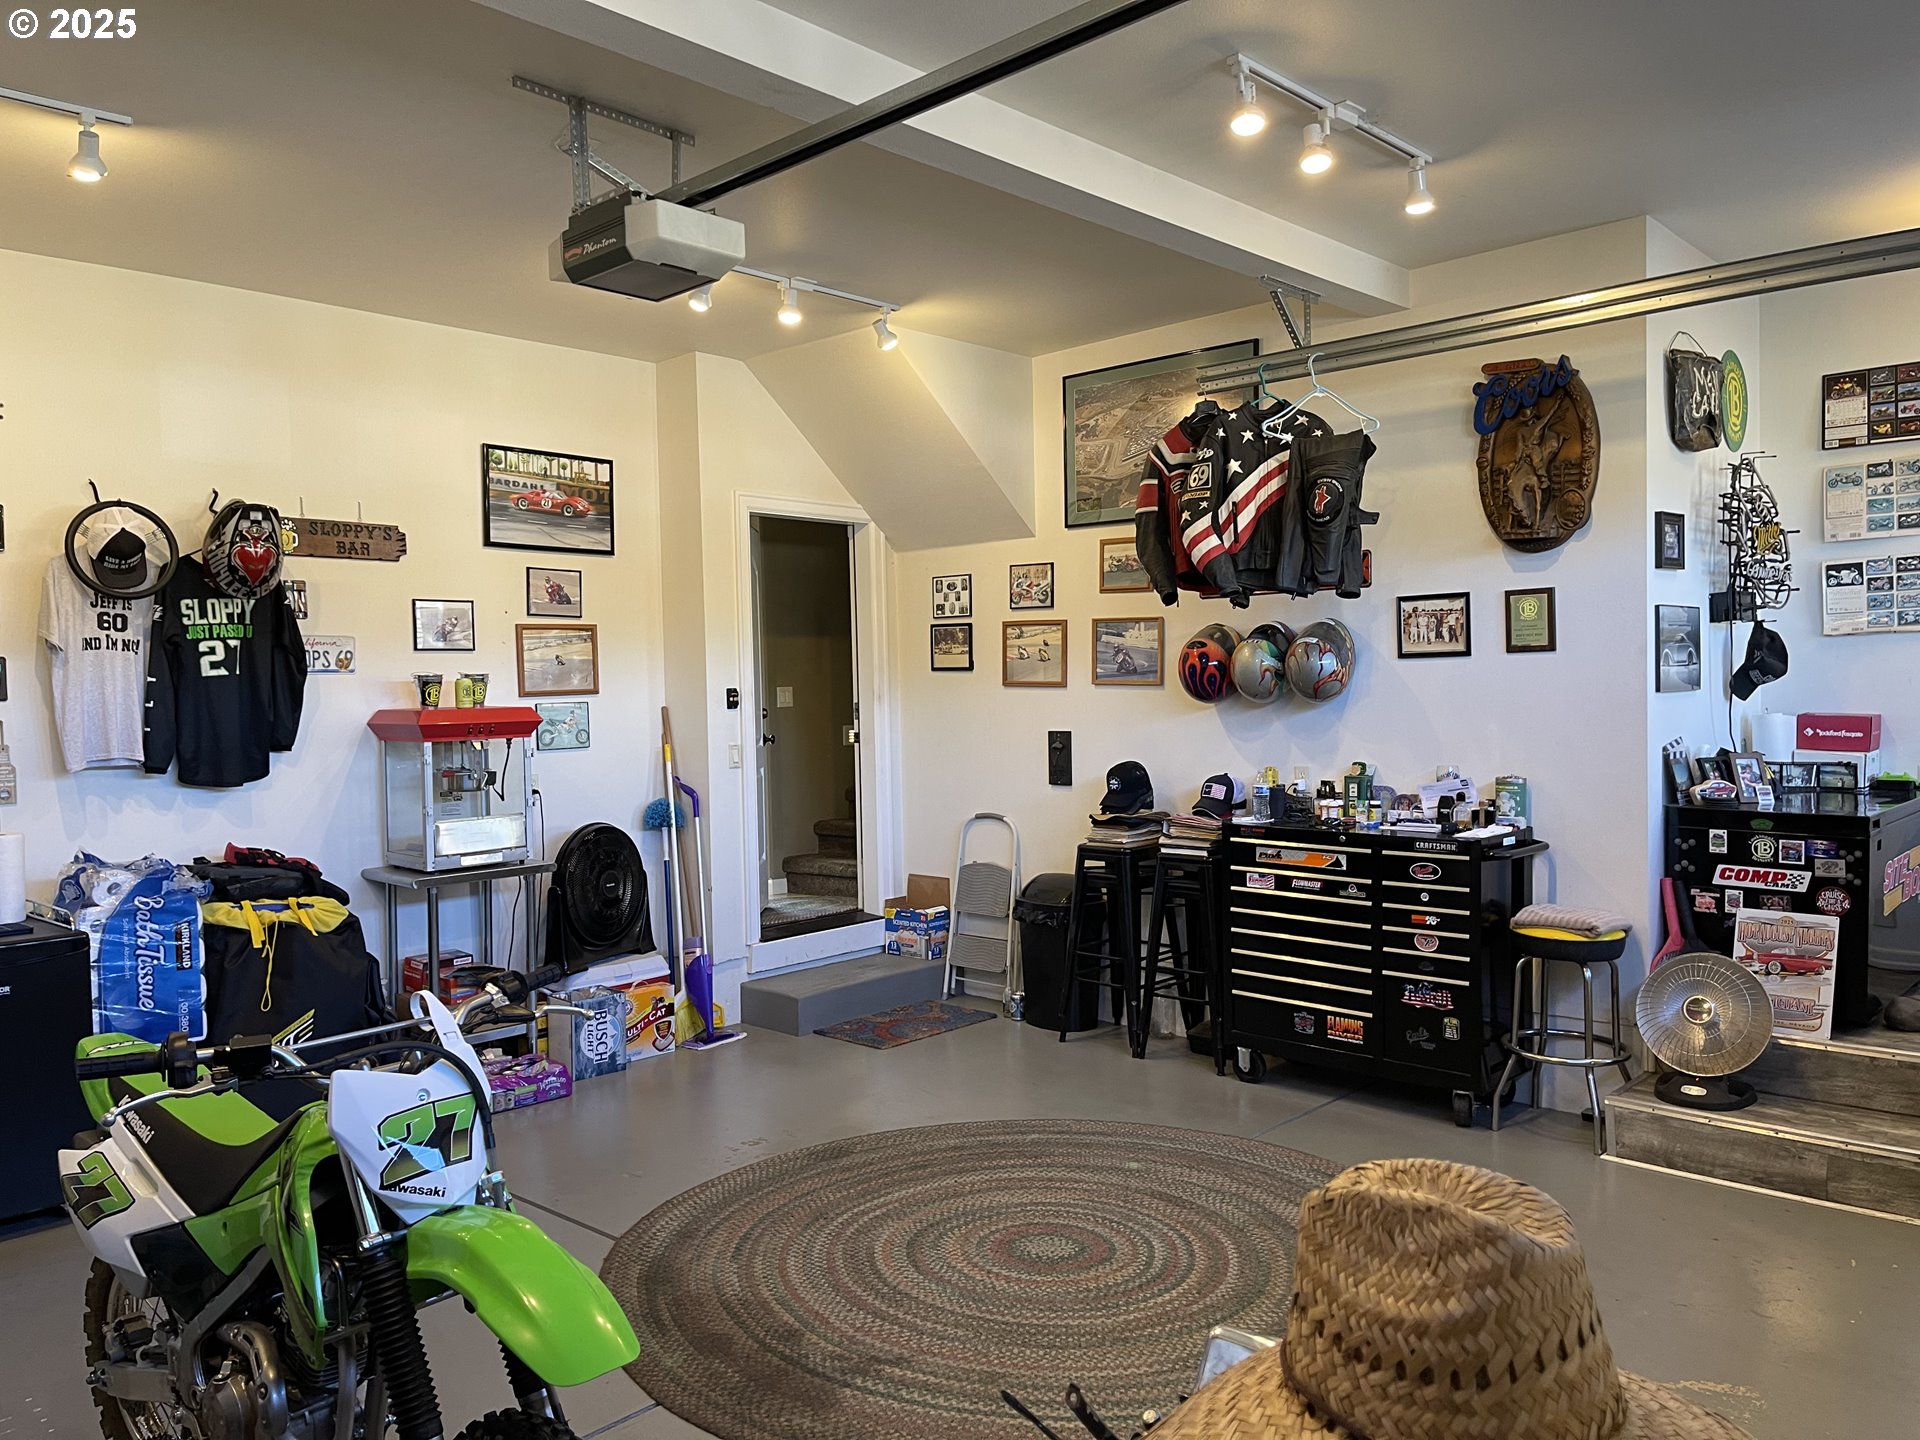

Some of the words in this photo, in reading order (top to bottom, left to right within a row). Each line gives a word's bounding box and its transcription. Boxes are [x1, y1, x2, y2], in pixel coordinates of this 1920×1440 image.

[583, 238, 617, 255] Phantom
[1472, 354, 1572, 436] Coors
[1190, 465, 1209, 487] 69
[309, 522, 393, 541] SLOPPY'S
[336, 541, 370, 556] BAR
[97, 611, 128, 633] 60
[180, 598, 256, 625] SLOPPY
[186, 625, 210, 639] JUST
[198, 639, 241, 677] 27
[1416, 841, 1456, 851] CRAFTSMAN
[1718, 867, 1788, 884] COMP
[1764, 881, 1798, 890] CAMS
[134, 896, 165, 949] Bath
[181, 922, 191, 968] KIRKLAND
[135, 945, 166, 1011] Tissue
[627, 1008, 666, 1037] ULTI-CAT
[1327, 1015, 1364, 1035] FLAMING
[594, 1008, 608, 1064] BUSCH
[117, 1094, 155, 1144] Kwasaki
[378, 1091, 477, 1190] 27
